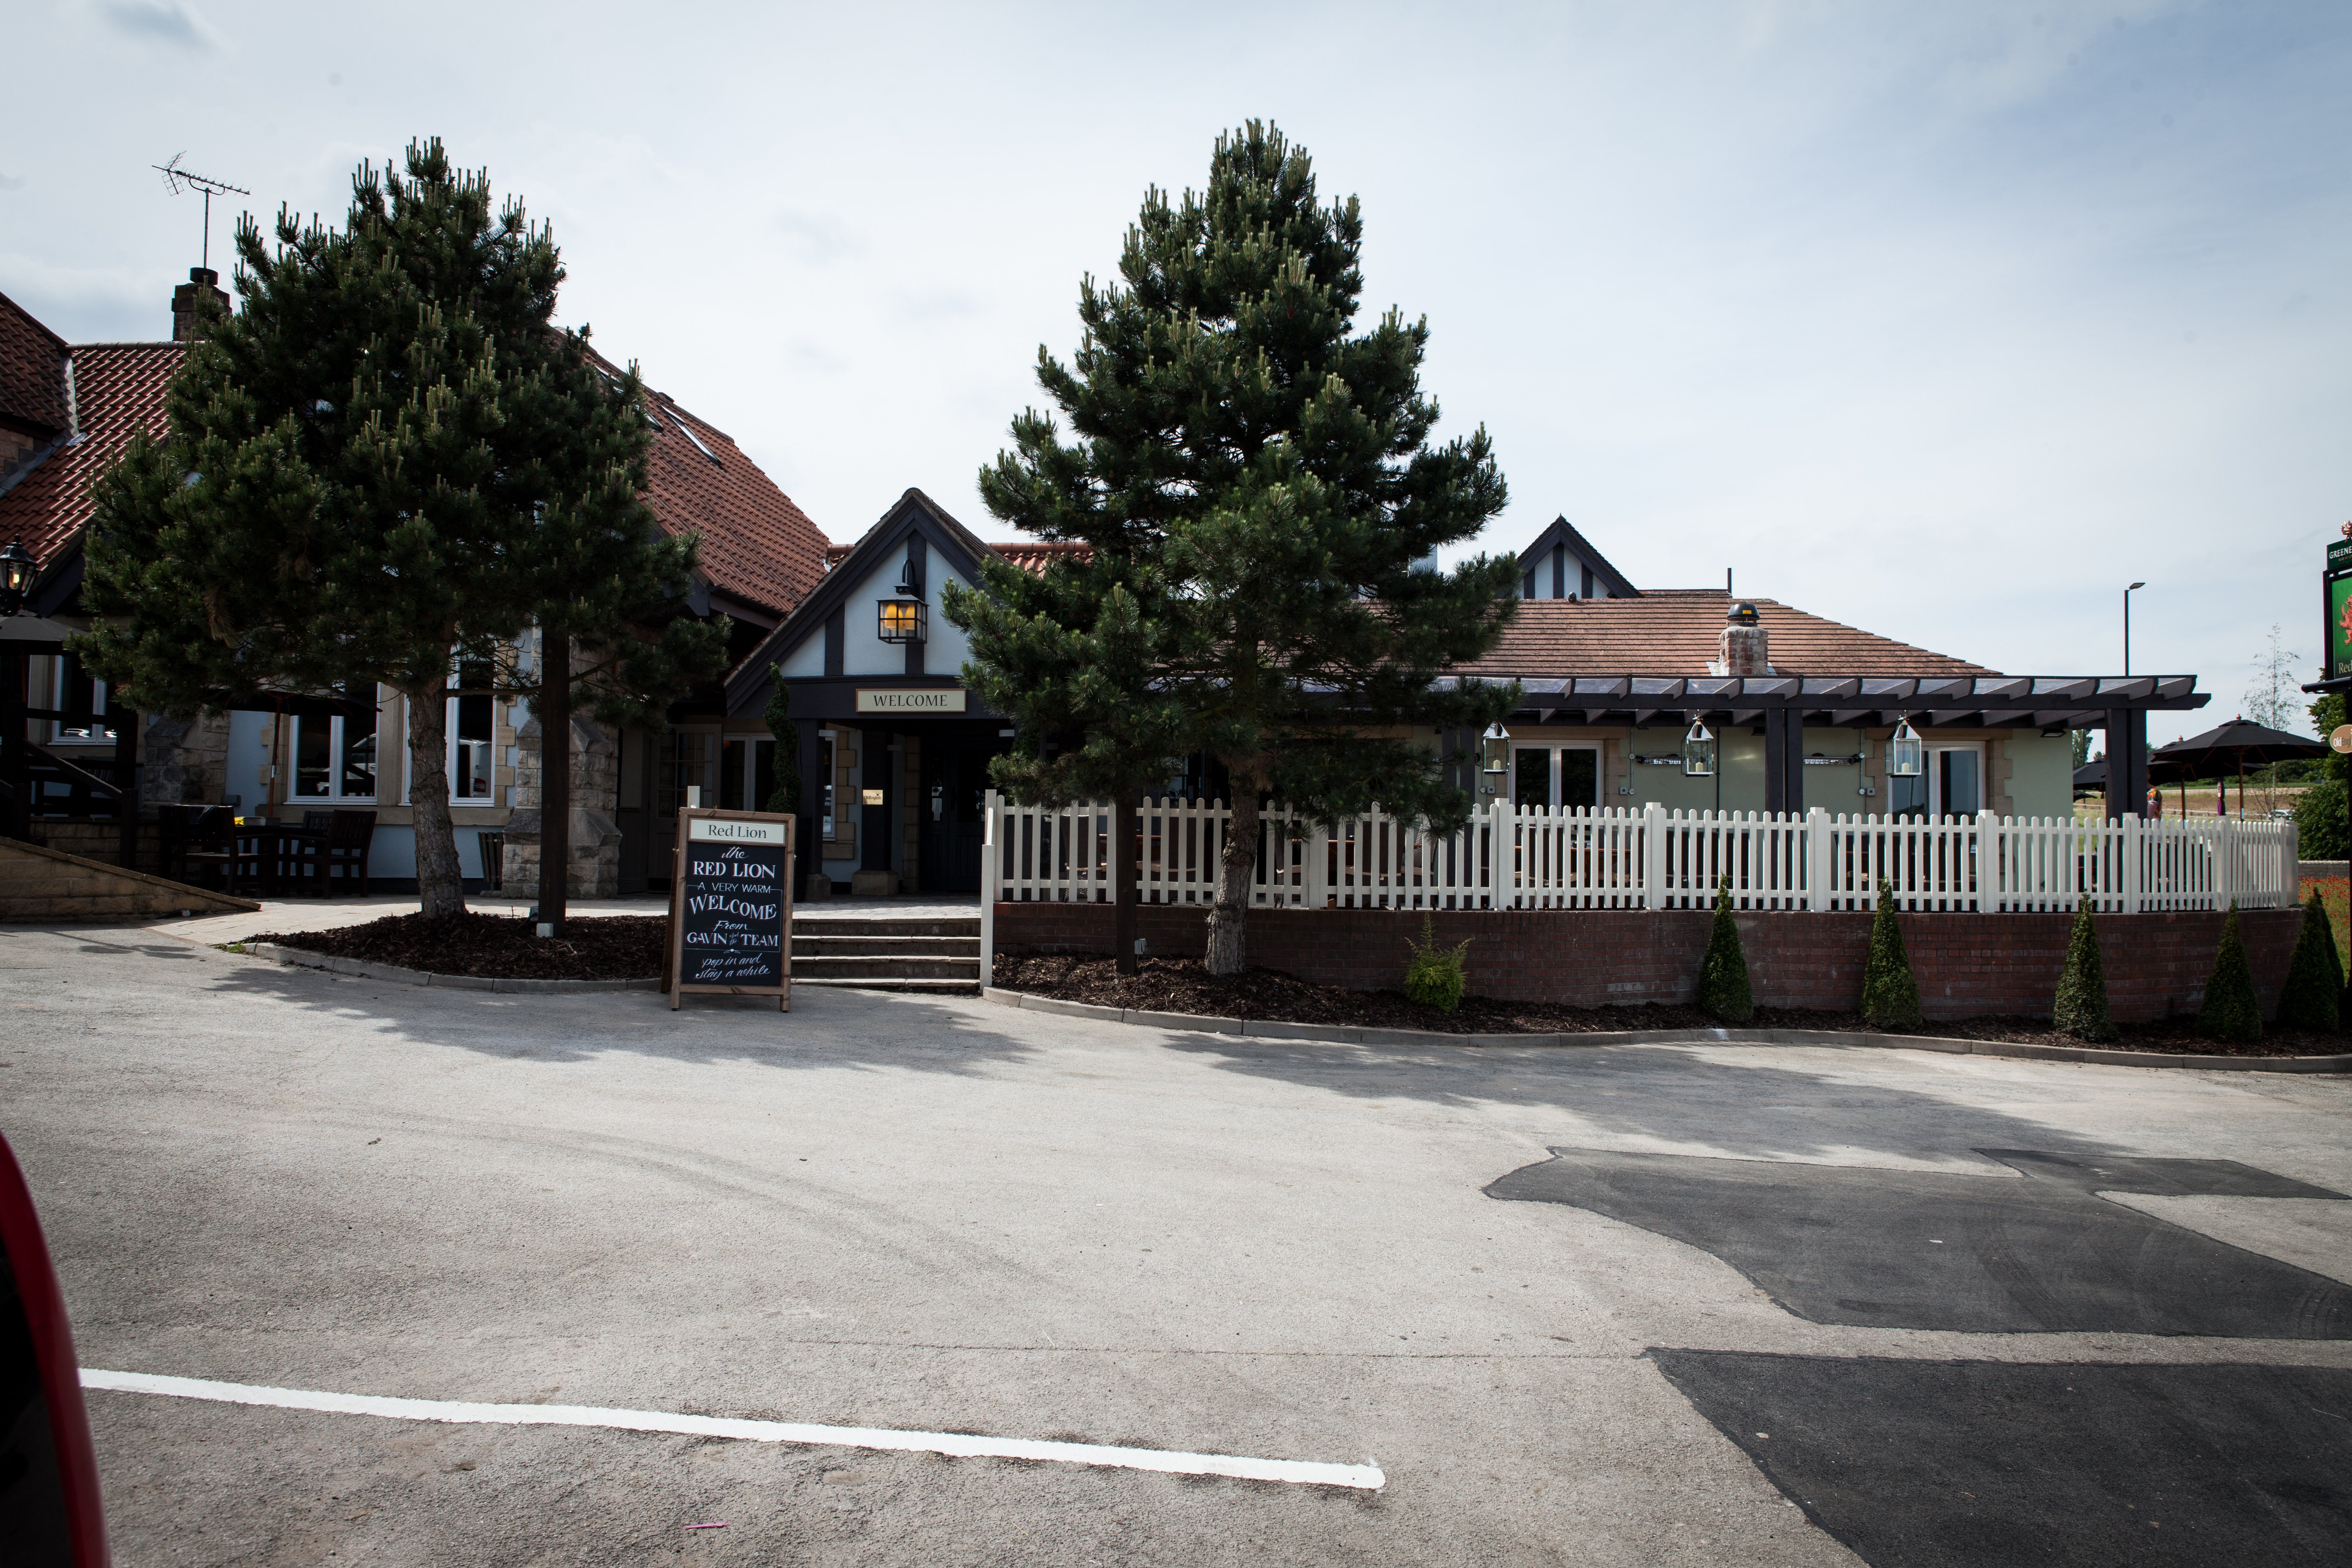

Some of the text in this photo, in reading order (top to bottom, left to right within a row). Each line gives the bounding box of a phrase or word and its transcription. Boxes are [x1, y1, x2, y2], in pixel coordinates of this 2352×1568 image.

[2329, 546, 2352, 559] GREENE
[2339, 660, 2352, 673] Red
[873, 695, 947, 707] WELCOME
[708, 824, 767, 838] Red Lion
[722, 846, 750, 859] the
[694, 861, 776, 879] RED LION
[697, 882, 771, 894] A VERY WARM
[689, 894, 777, 920] WELCOME
[713, 921, 748, 931] From
[687, 932, 728, 944] GAVIN
[740, 934, 779, 946] TEAM
[702, 952, 763, 968] pop in and
[694, 968, 722, 980] stay
[737, 965, 771, 977] while
